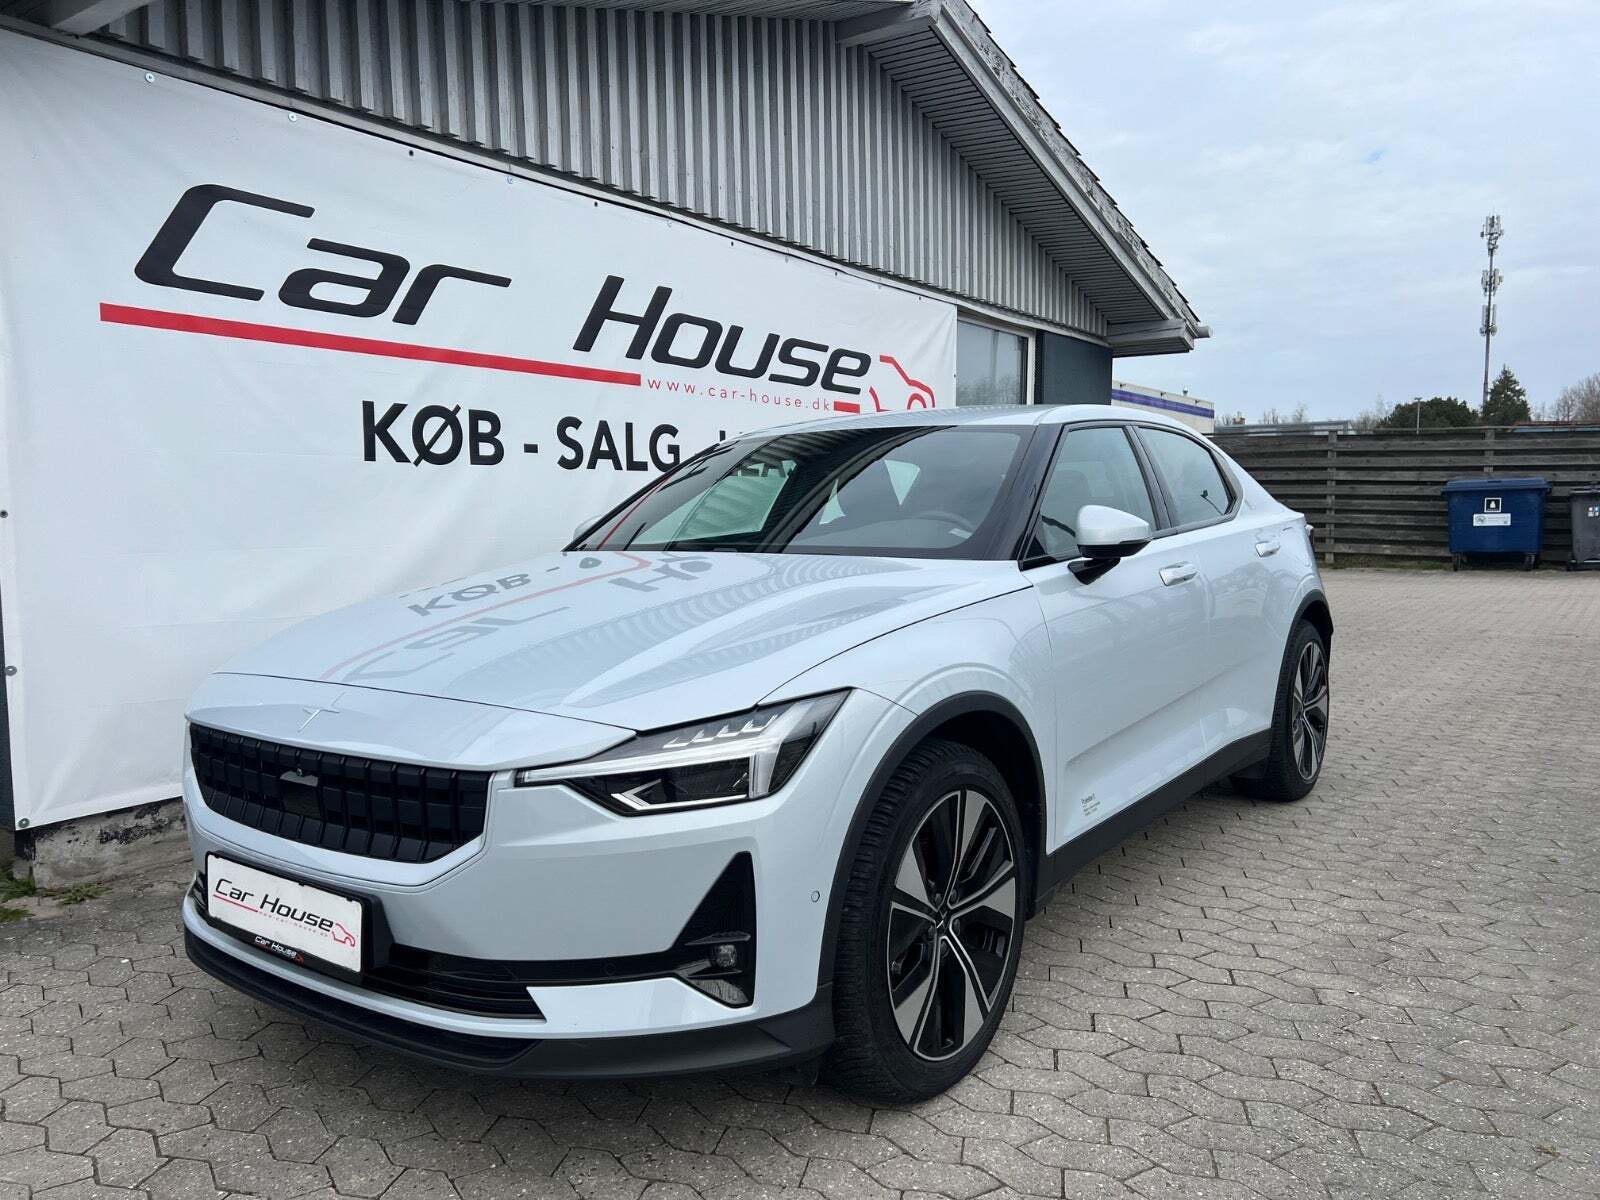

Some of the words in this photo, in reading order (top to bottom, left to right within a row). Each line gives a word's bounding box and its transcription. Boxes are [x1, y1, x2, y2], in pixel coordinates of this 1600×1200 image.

[134, 183, 513, 325] Car
[572, 274, 872, 395] House
[648, 379, 830, 411] www.car-house.dk
[362, 400, 505, 467] KØB
[556, 415, 681, 473] SALG
[215, 878, 254, 903] Car
[259, 893, 334, 933] House
[254, 935, 271, 946] Car
[271, 942, 298, 960] House
